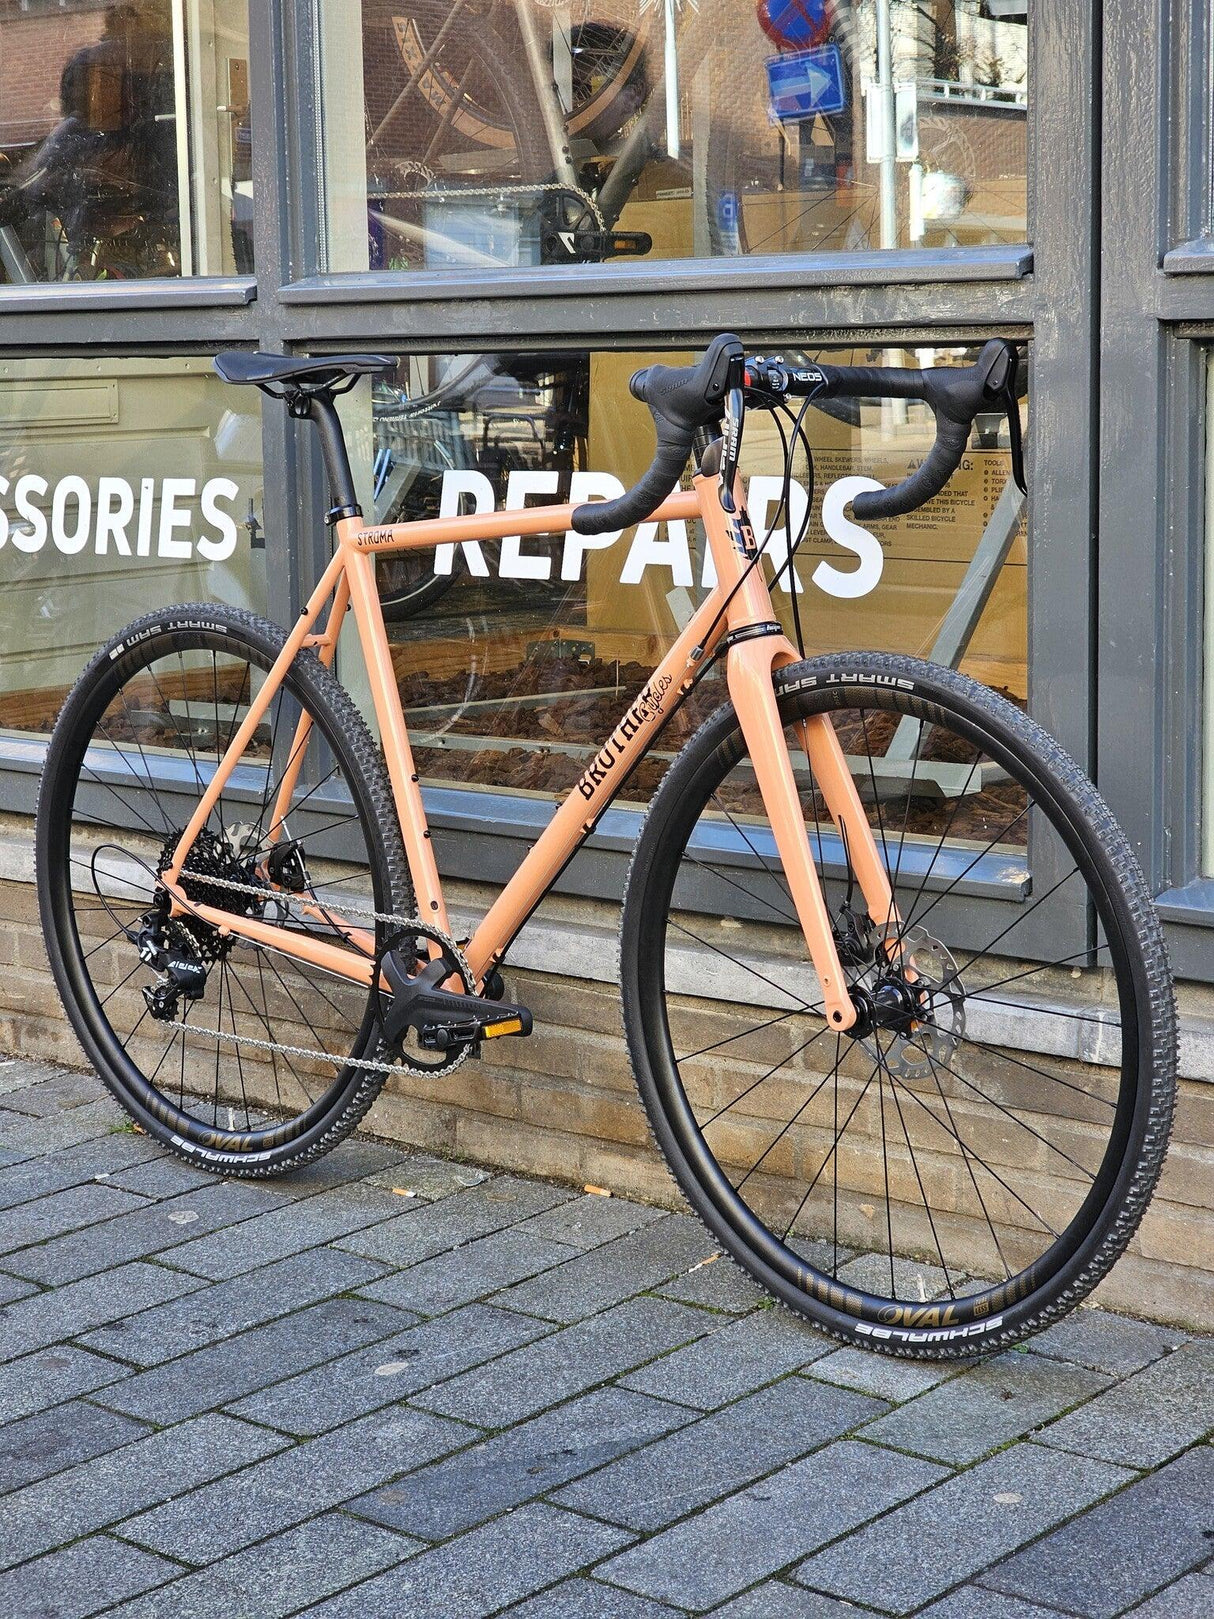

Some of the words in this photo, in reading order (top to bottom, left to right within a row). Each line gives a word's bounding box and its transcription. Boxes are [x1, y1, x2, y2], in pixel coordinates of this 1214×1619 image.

[728, 417, 740, 462] SRAM
[0, 474, 239, 561] SORIES
[357, 529, 395, 546] STROMA
[433, 469, 884, 598] REPARS
[126, 625, 162, 647] SAM
[167, 620, 228, 634] SMART
[826, 673, 915, 691] SMART
[638, 673, 673, 722] Cycles
[170, 1134, 273, 1164] SCHWALBE
[854, 1315, 1004, 1343] SCHWALBE
[877, 1304, 960, 1328] OVAL
